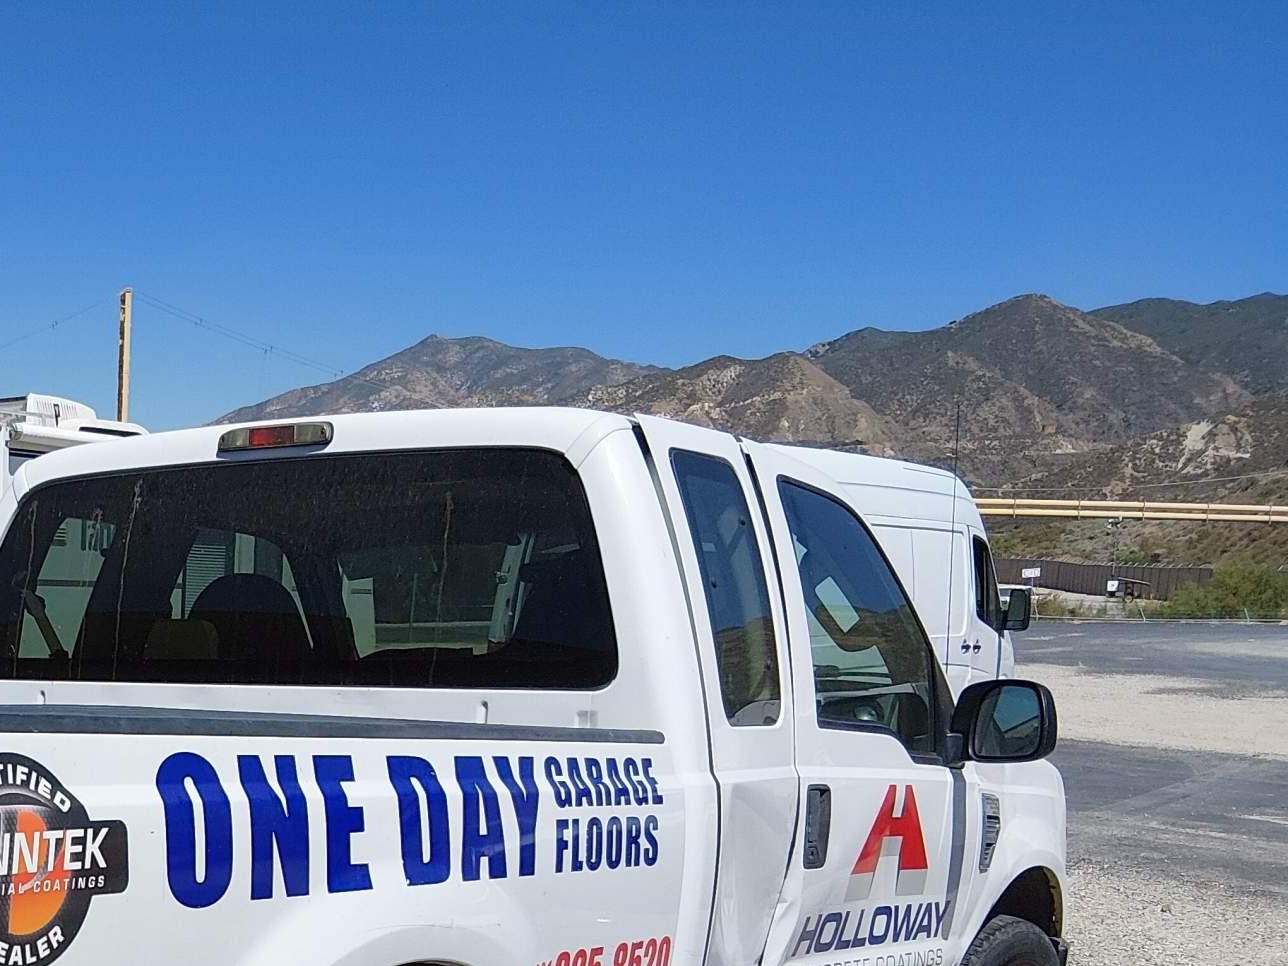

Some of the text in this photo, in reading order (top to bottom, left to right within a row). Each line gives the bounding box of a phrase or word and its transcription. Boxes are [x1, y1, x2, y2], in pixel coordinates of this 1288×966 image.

[543, 756, 664, 808] GARAGE
[155, 752, 540, 909] ONE DAY
[555, 815, 659, 874] FLOORS
[33, 875, 106, 893] COATINGS
[791, 901, 951, 957] HOLLOWAY
